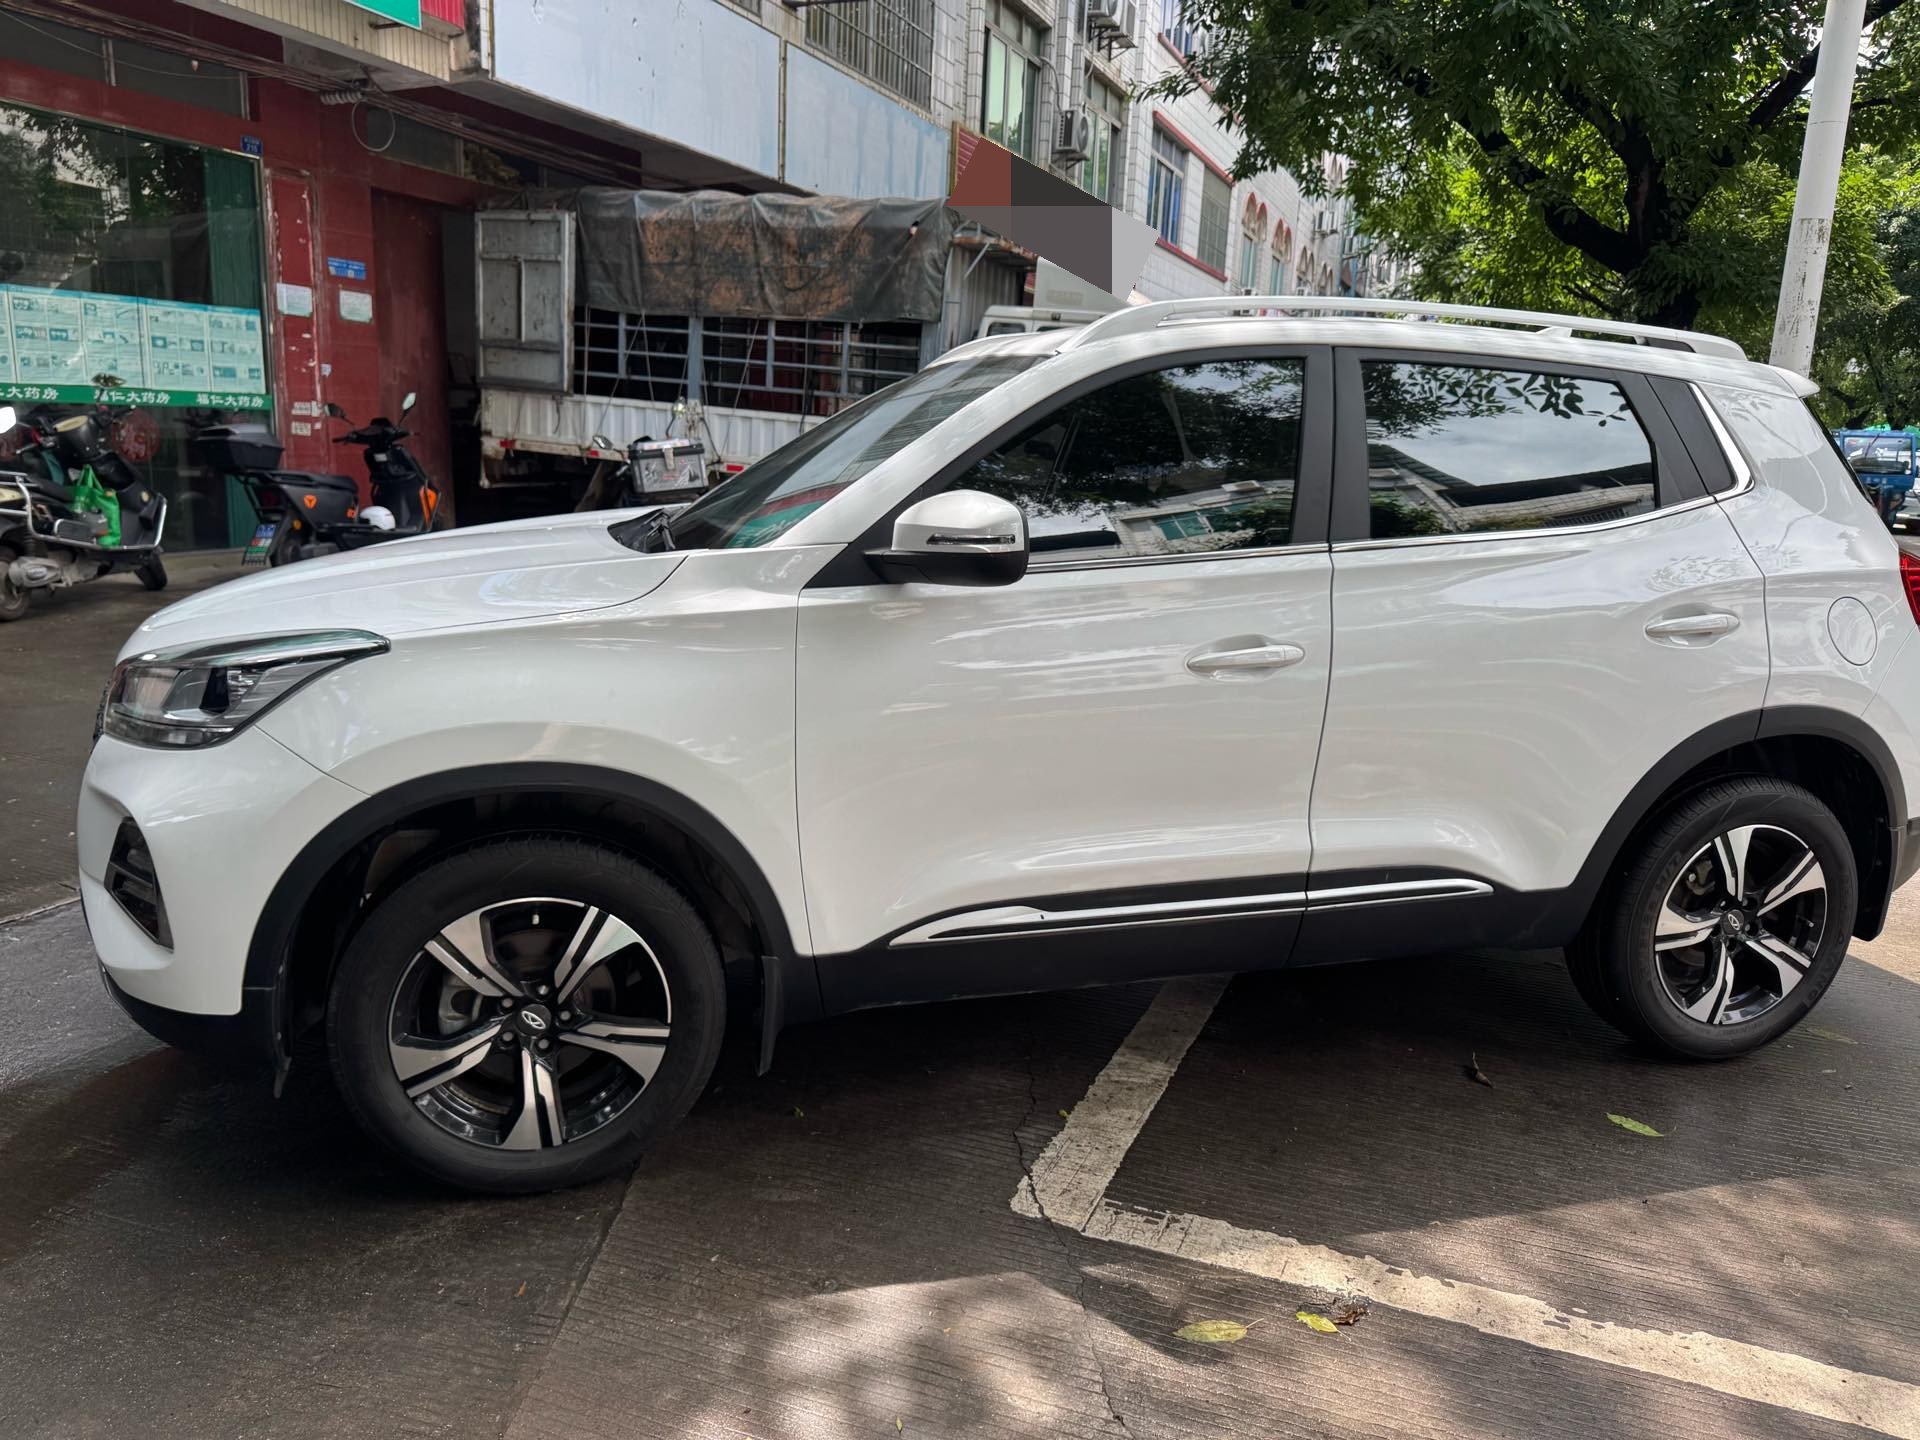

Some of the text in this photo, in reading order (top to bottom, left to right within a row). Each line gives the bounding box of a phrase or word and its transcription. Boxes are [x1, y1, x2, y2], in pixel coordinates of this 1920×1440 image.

[196, 393, 265, 408] 福仁大药房
